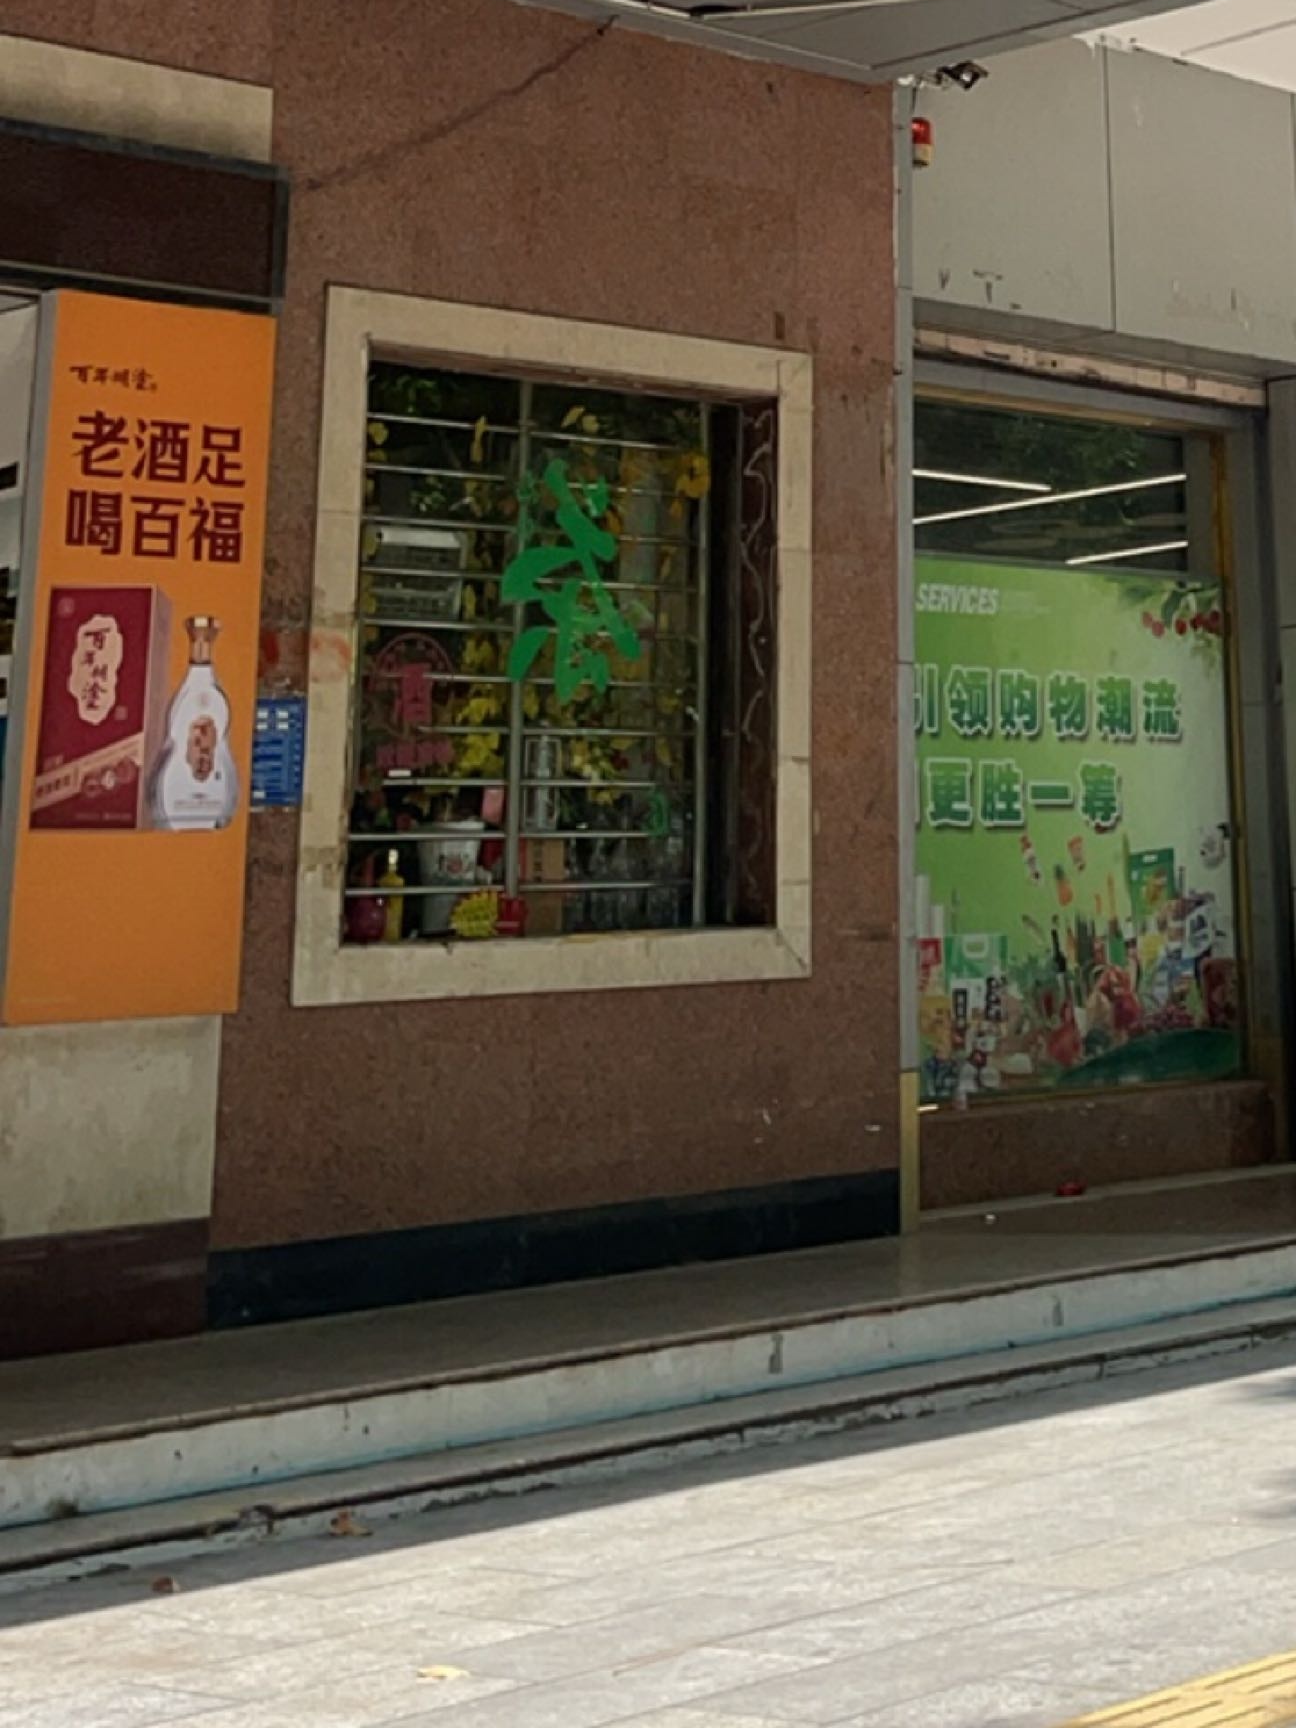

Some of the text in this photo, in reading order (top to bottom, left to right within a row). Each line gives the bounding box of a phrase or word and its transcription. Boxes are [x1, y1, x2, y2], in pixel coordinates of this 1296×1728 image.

[71, 409, 246, 489] 老酒足
[64, 487, 245, 564] 喝百福
[915, 582, 1000, 615] SERVICES
[926, 756, 1122, 830] 更胜一筹
